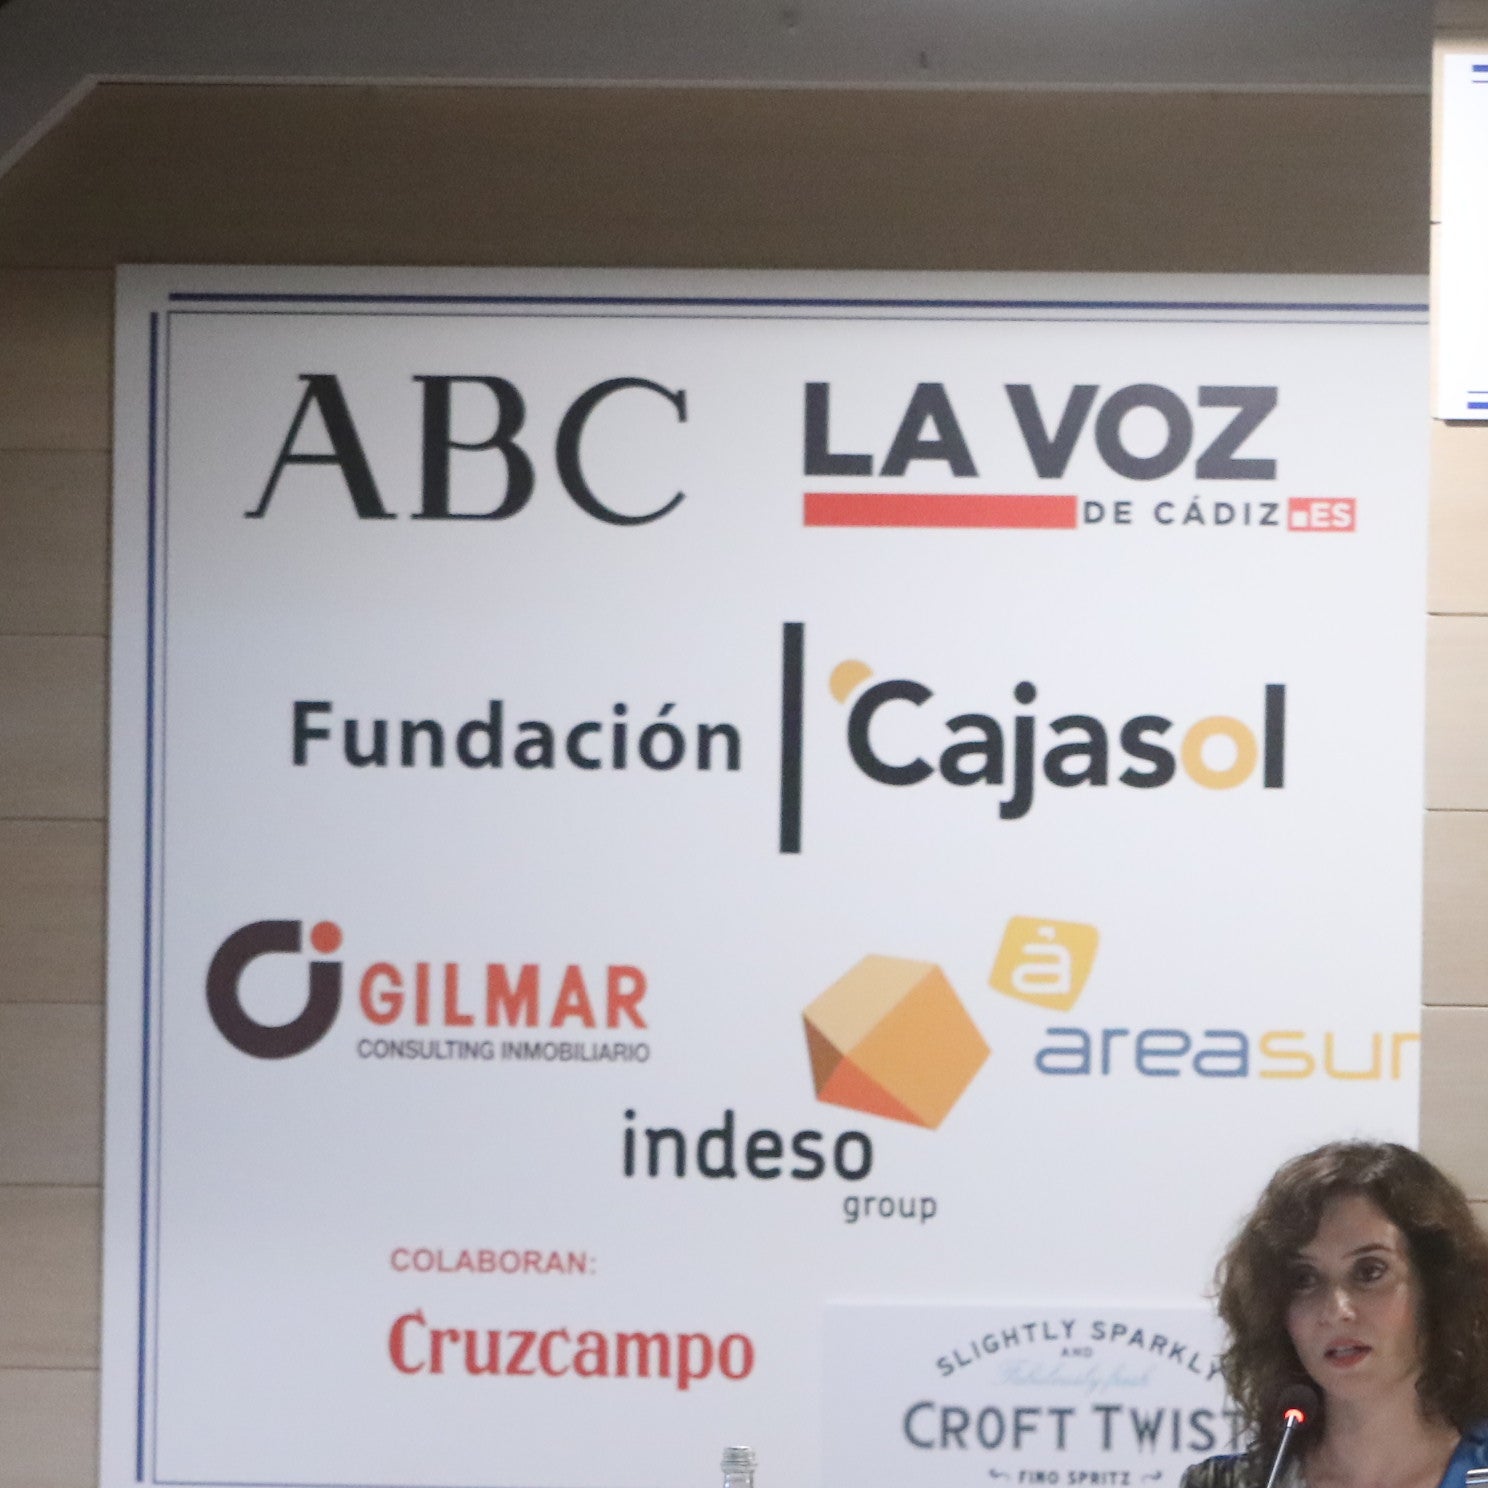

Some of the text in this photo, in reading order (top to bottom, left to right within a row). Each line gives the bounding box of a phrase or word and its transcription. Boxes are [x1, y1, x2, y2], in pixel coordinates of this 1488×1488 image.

[243, 373, 686, 526] ABC
[804, 382, 1277, 481] LA VOZ
[1084, 501, 1132, 524] DE
[1153, 496, 1279, 526] CÁDIZ
[292, 679, 1285, 820] Fundación Cajasol
[359, 962, 646, 1028] GILMAR
[356, 1038, 650, 1063] CONSULTING INMOBILIARIO
[1035, 1026, 1420, 1081] areasur
[621, 1109, 873, 1179] indeso
[843, 1196, 937, 1224] group
[390, 1247, 594, 1274] COLABORAN:
[388, 1309, 754, 1391] Cruzcampo
[936, 1319, 1224, 1381] SLIGHTLY SPARKLY
[1060, 1347, 1094, 1358] AND
[903, 1400, 1075, 1450] CROFT
[1068, 1470, 1130, 1486] SPRITZ
